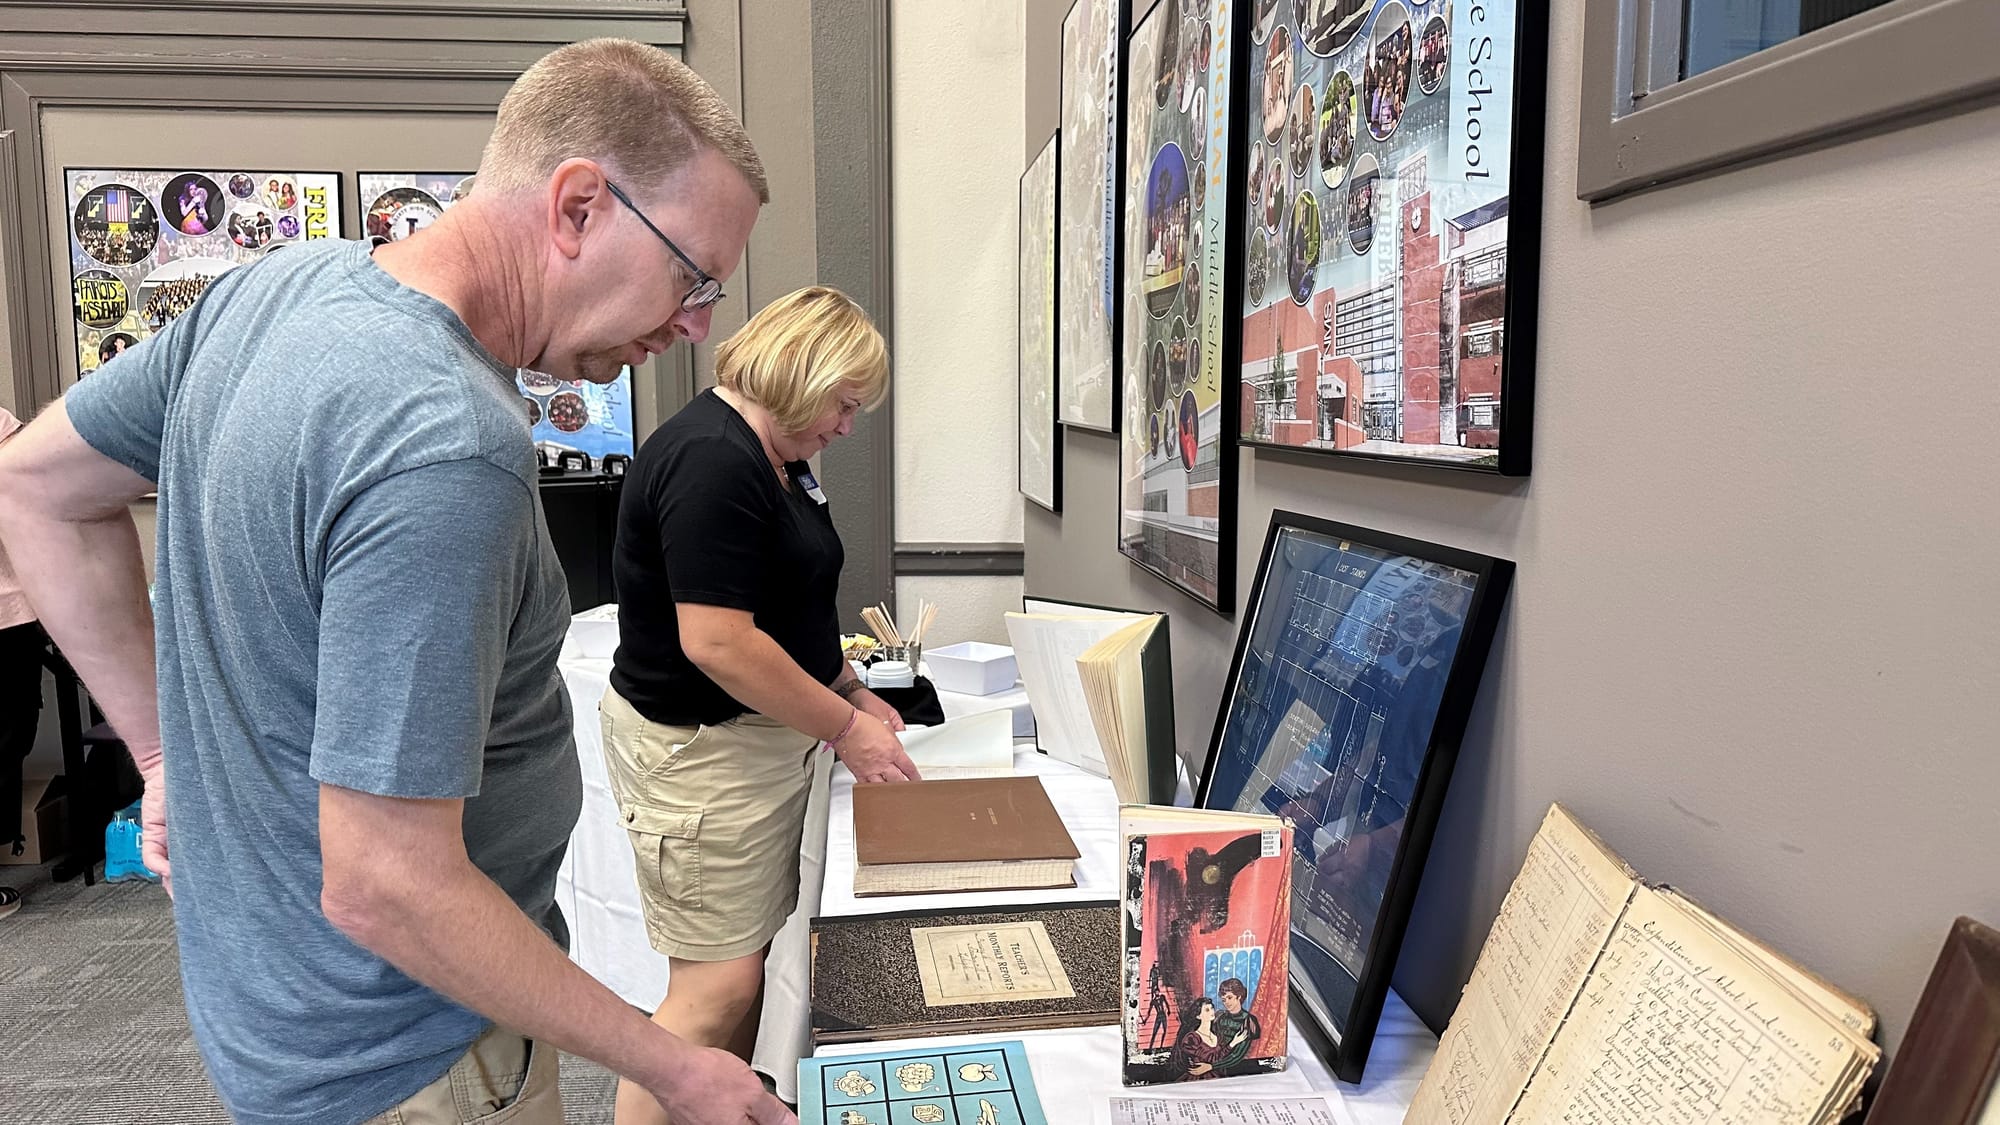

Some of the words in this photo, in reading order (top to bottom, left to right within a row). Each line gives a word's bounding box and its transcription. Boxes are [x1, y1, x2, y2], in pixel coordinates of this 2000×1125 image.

[1211, 0, 1228, 201] OUGHAL
[1465, 36, 1493, 183] School
[304, 186, 329, 240] FRE
[1208, 216, 1221, 306] Middle
[1206, 311, 1218, 393] School
[987, 931, 1005, 960] MONTHLY
[997, 961, 1016, 991] REPORTS
[1009, 942, 1030, 976] TEACHER'S
[1689, 966, 1713, 983] of
[1828, 1037, 1844, 1052] 53
